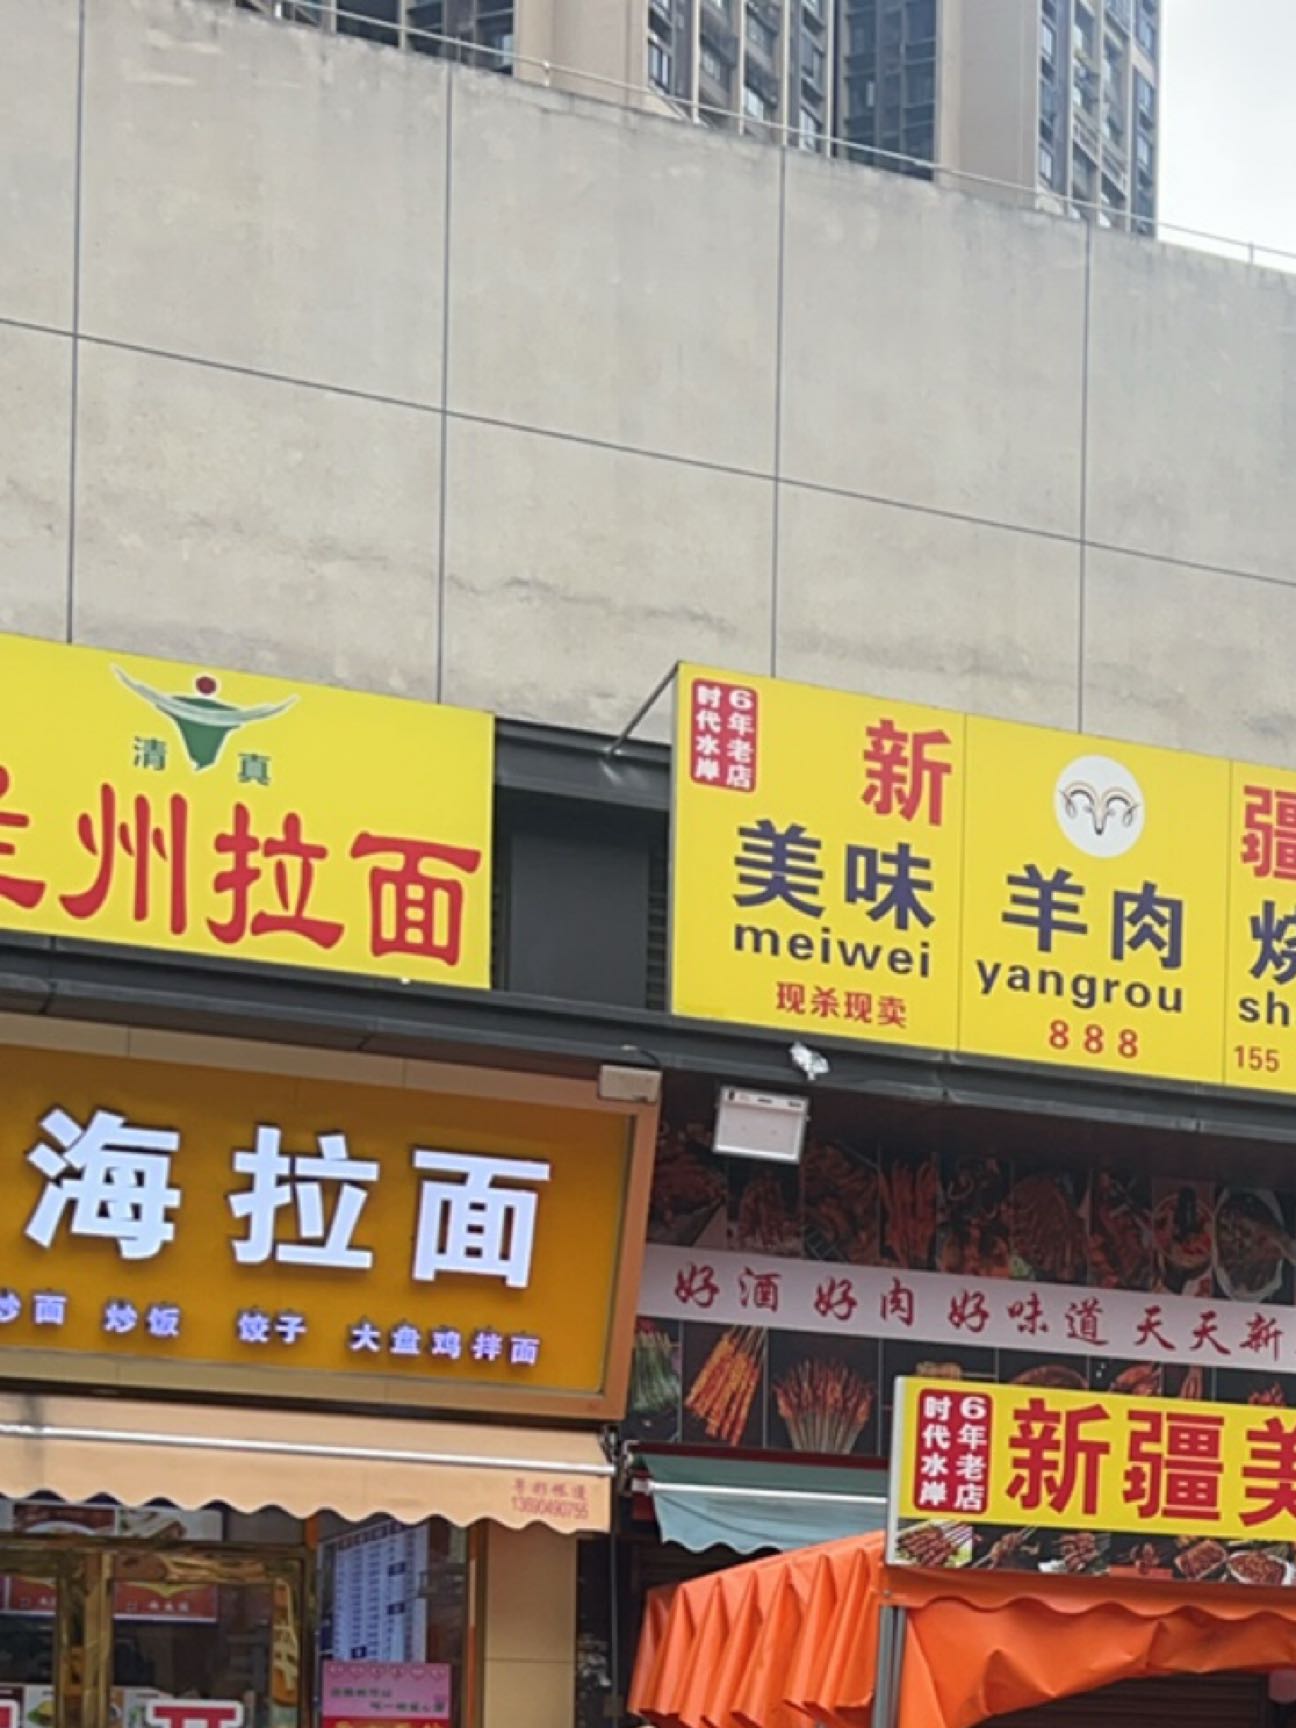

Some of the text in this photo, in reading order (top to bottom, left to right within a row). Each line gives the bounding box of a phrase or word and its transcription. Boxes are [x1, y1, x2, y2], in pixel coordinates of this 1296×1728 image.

[697, 685, 720, 780] 时代水岸
[727, 690, 753, 790] 6年老店
[863, 718, 952, 827] 新
[733, 819, 935, 930] 美味
[1002, 864, 1184, 970] 羊肉
[733, 923, 931, 980] meiwei
[976, 958, 1184, 1014] yangrou
[775, 981, 908, 1030] 现杀现卖
[1234, 1045, 1280, 1073] 155
[25, 1107, 550, 1289] 海拉面
[105, 1303, 181, 1338] 炒饭
[237, 1311, 308, 1345] 饺子
[351, 1323, 541, 1367] 大盘鸡拌面
[921, 1396, 946, 1507] 时代水岸
[956, 1396, 987, 1512] 6年老店
